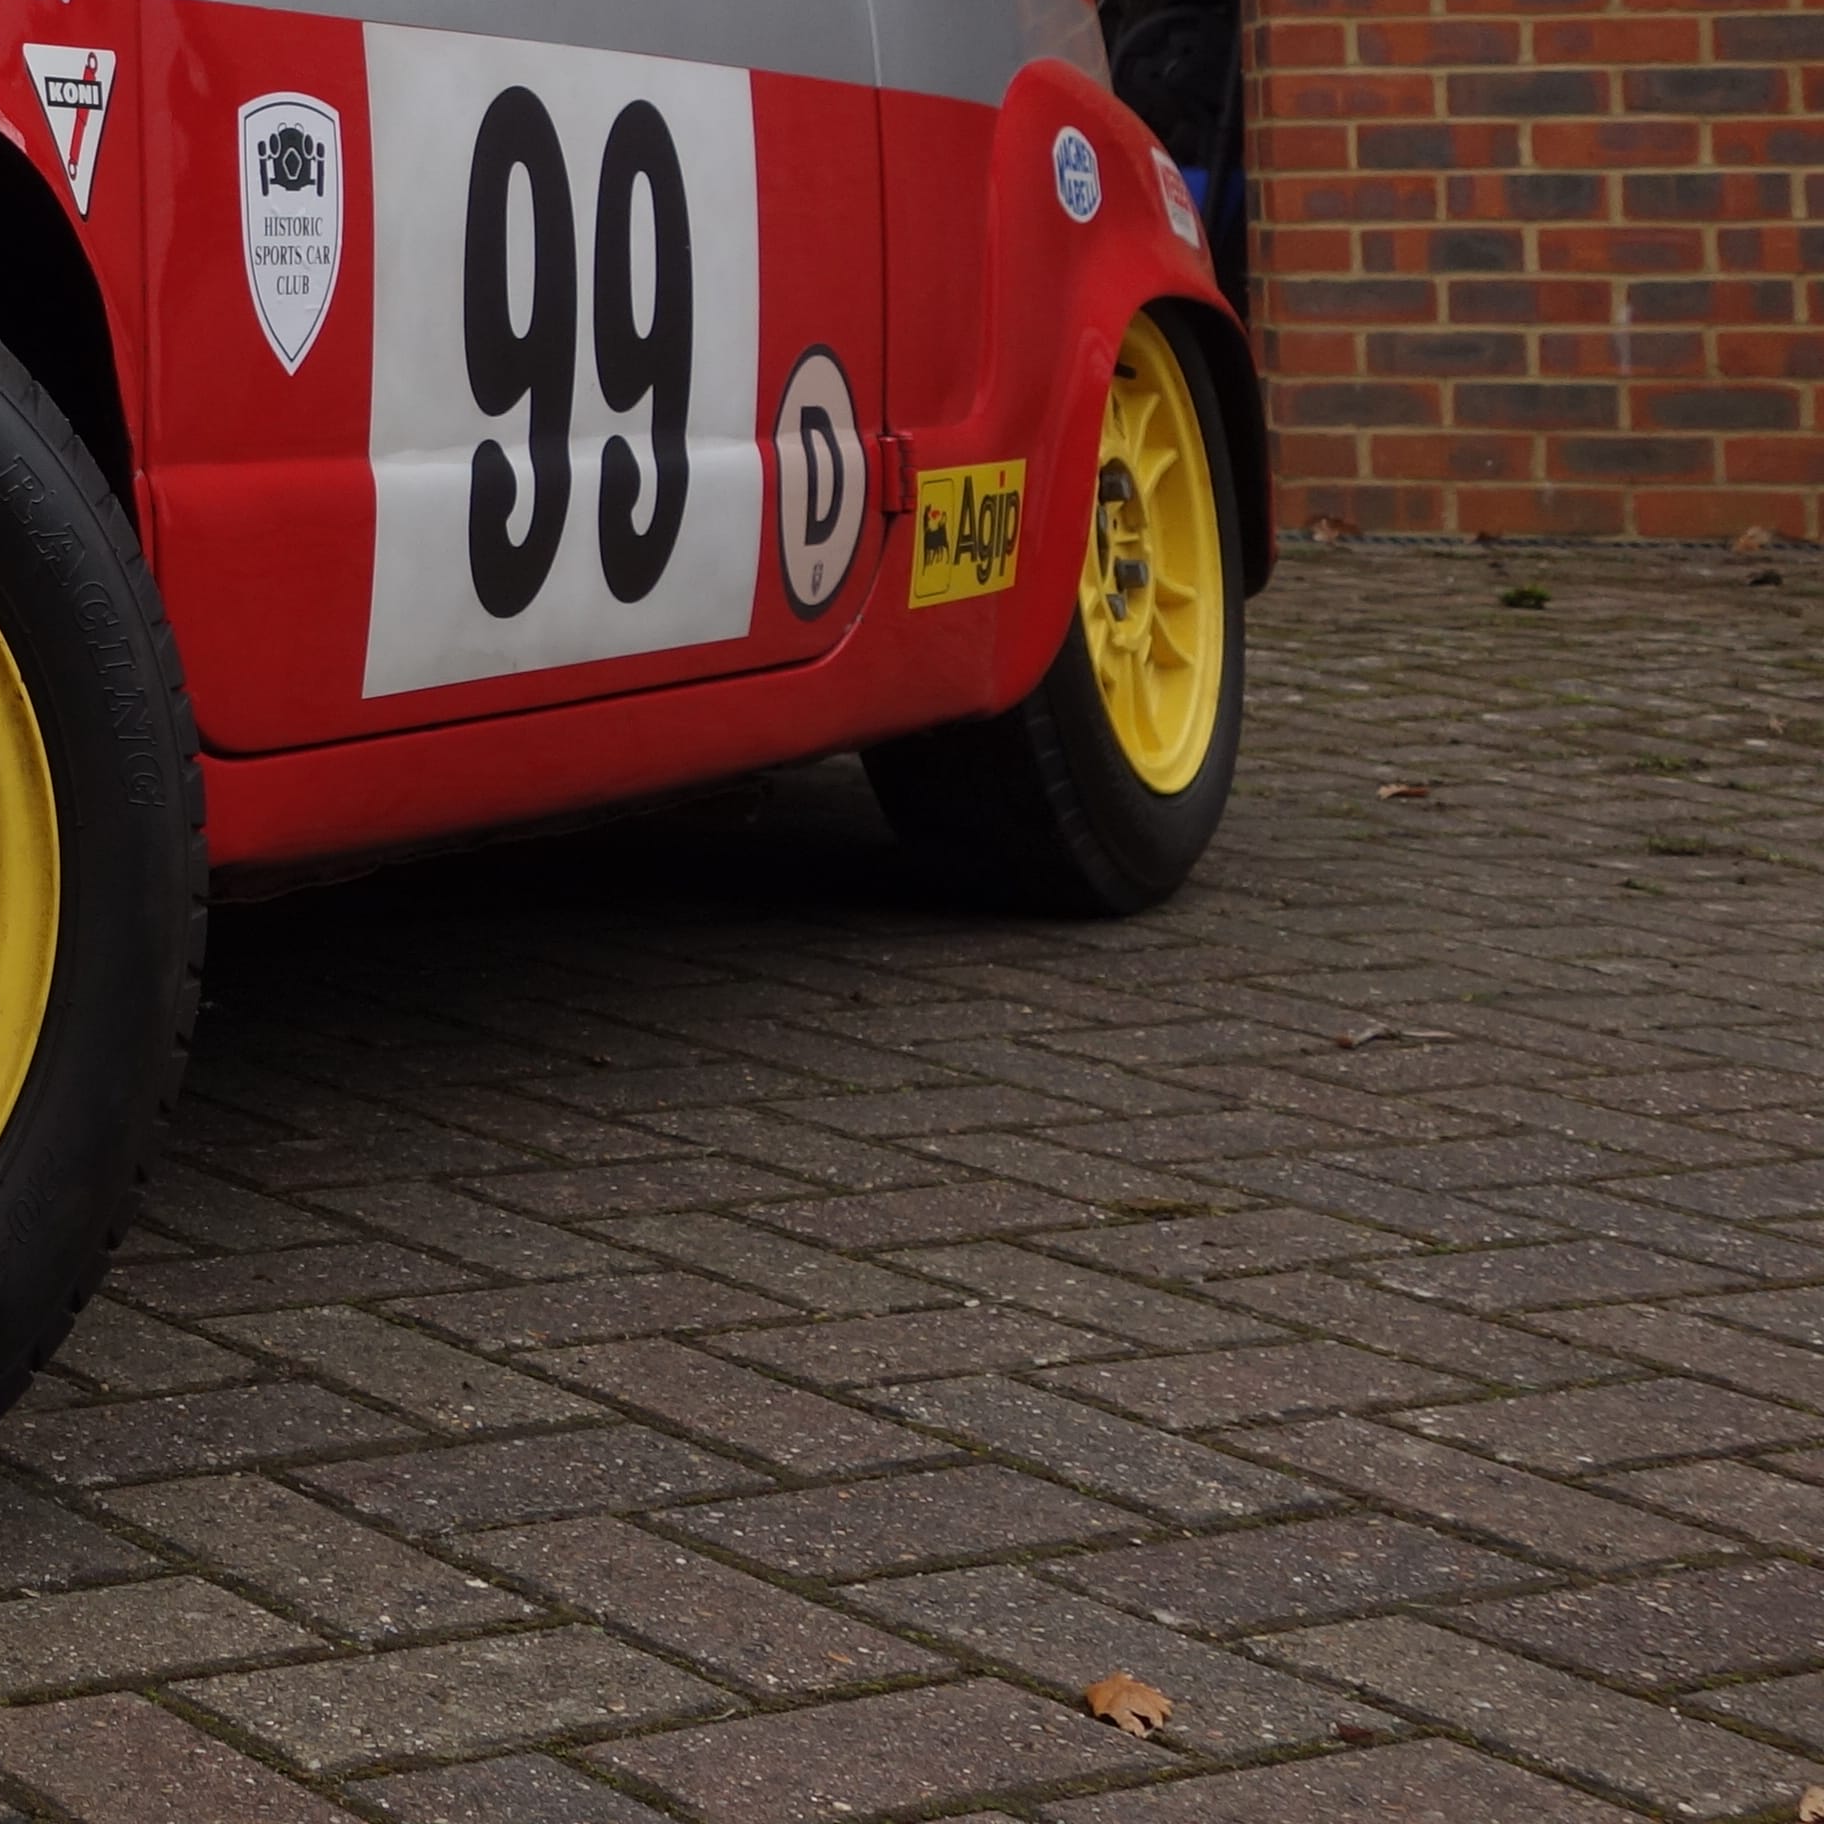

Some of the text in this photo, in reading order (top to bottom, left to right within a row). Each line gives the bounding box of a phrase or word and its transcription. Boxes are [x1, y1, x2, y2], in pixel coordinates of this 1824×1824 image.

[48, 81, 99, 106] KONI
[264, 216, 323, 237] HISTORIC
[255, 245, 331, 266] SPORTS CAR
[276, 275, 310, 296] CLUB
[462, 84, 694, 620] 99
[799, 403, 844, 547] D
[953, 470, 1021, 586] Agip
